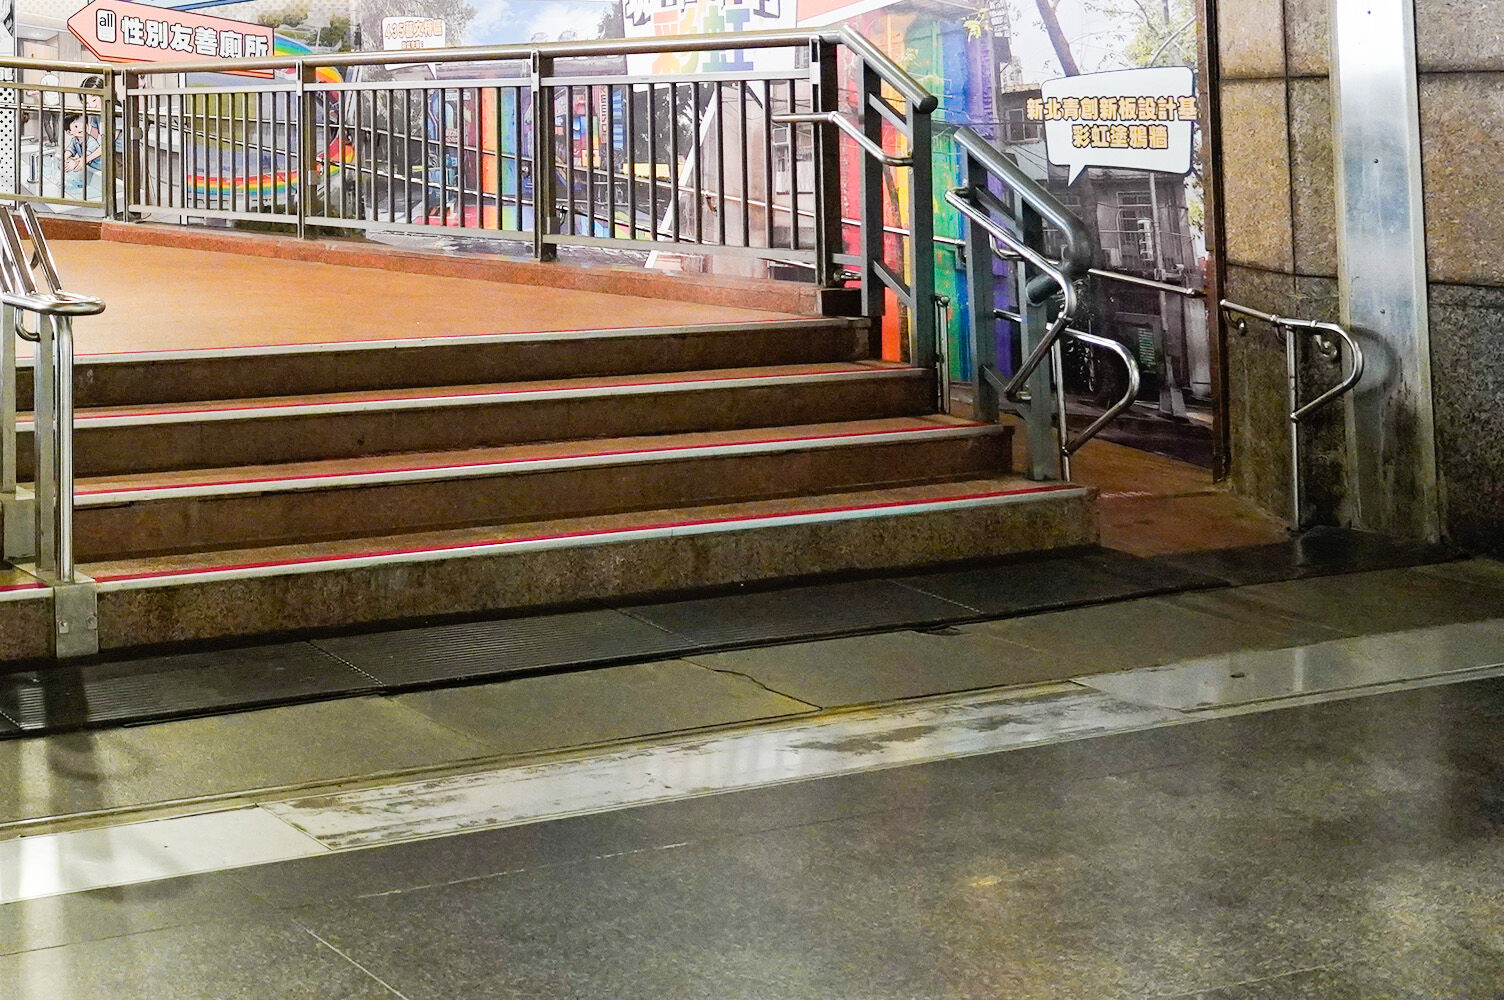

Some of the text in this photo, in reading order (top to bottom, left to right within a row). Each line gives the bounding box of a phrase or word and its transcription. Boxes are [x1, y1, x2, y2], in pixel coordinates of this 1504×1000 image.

[98, 13, 269, 58] all 性別友善廁所
[1026, 96, 1199, 121] 新北青創新板設計基
[1072, 124, 1169, 149] 彩虹塗鴉牆
